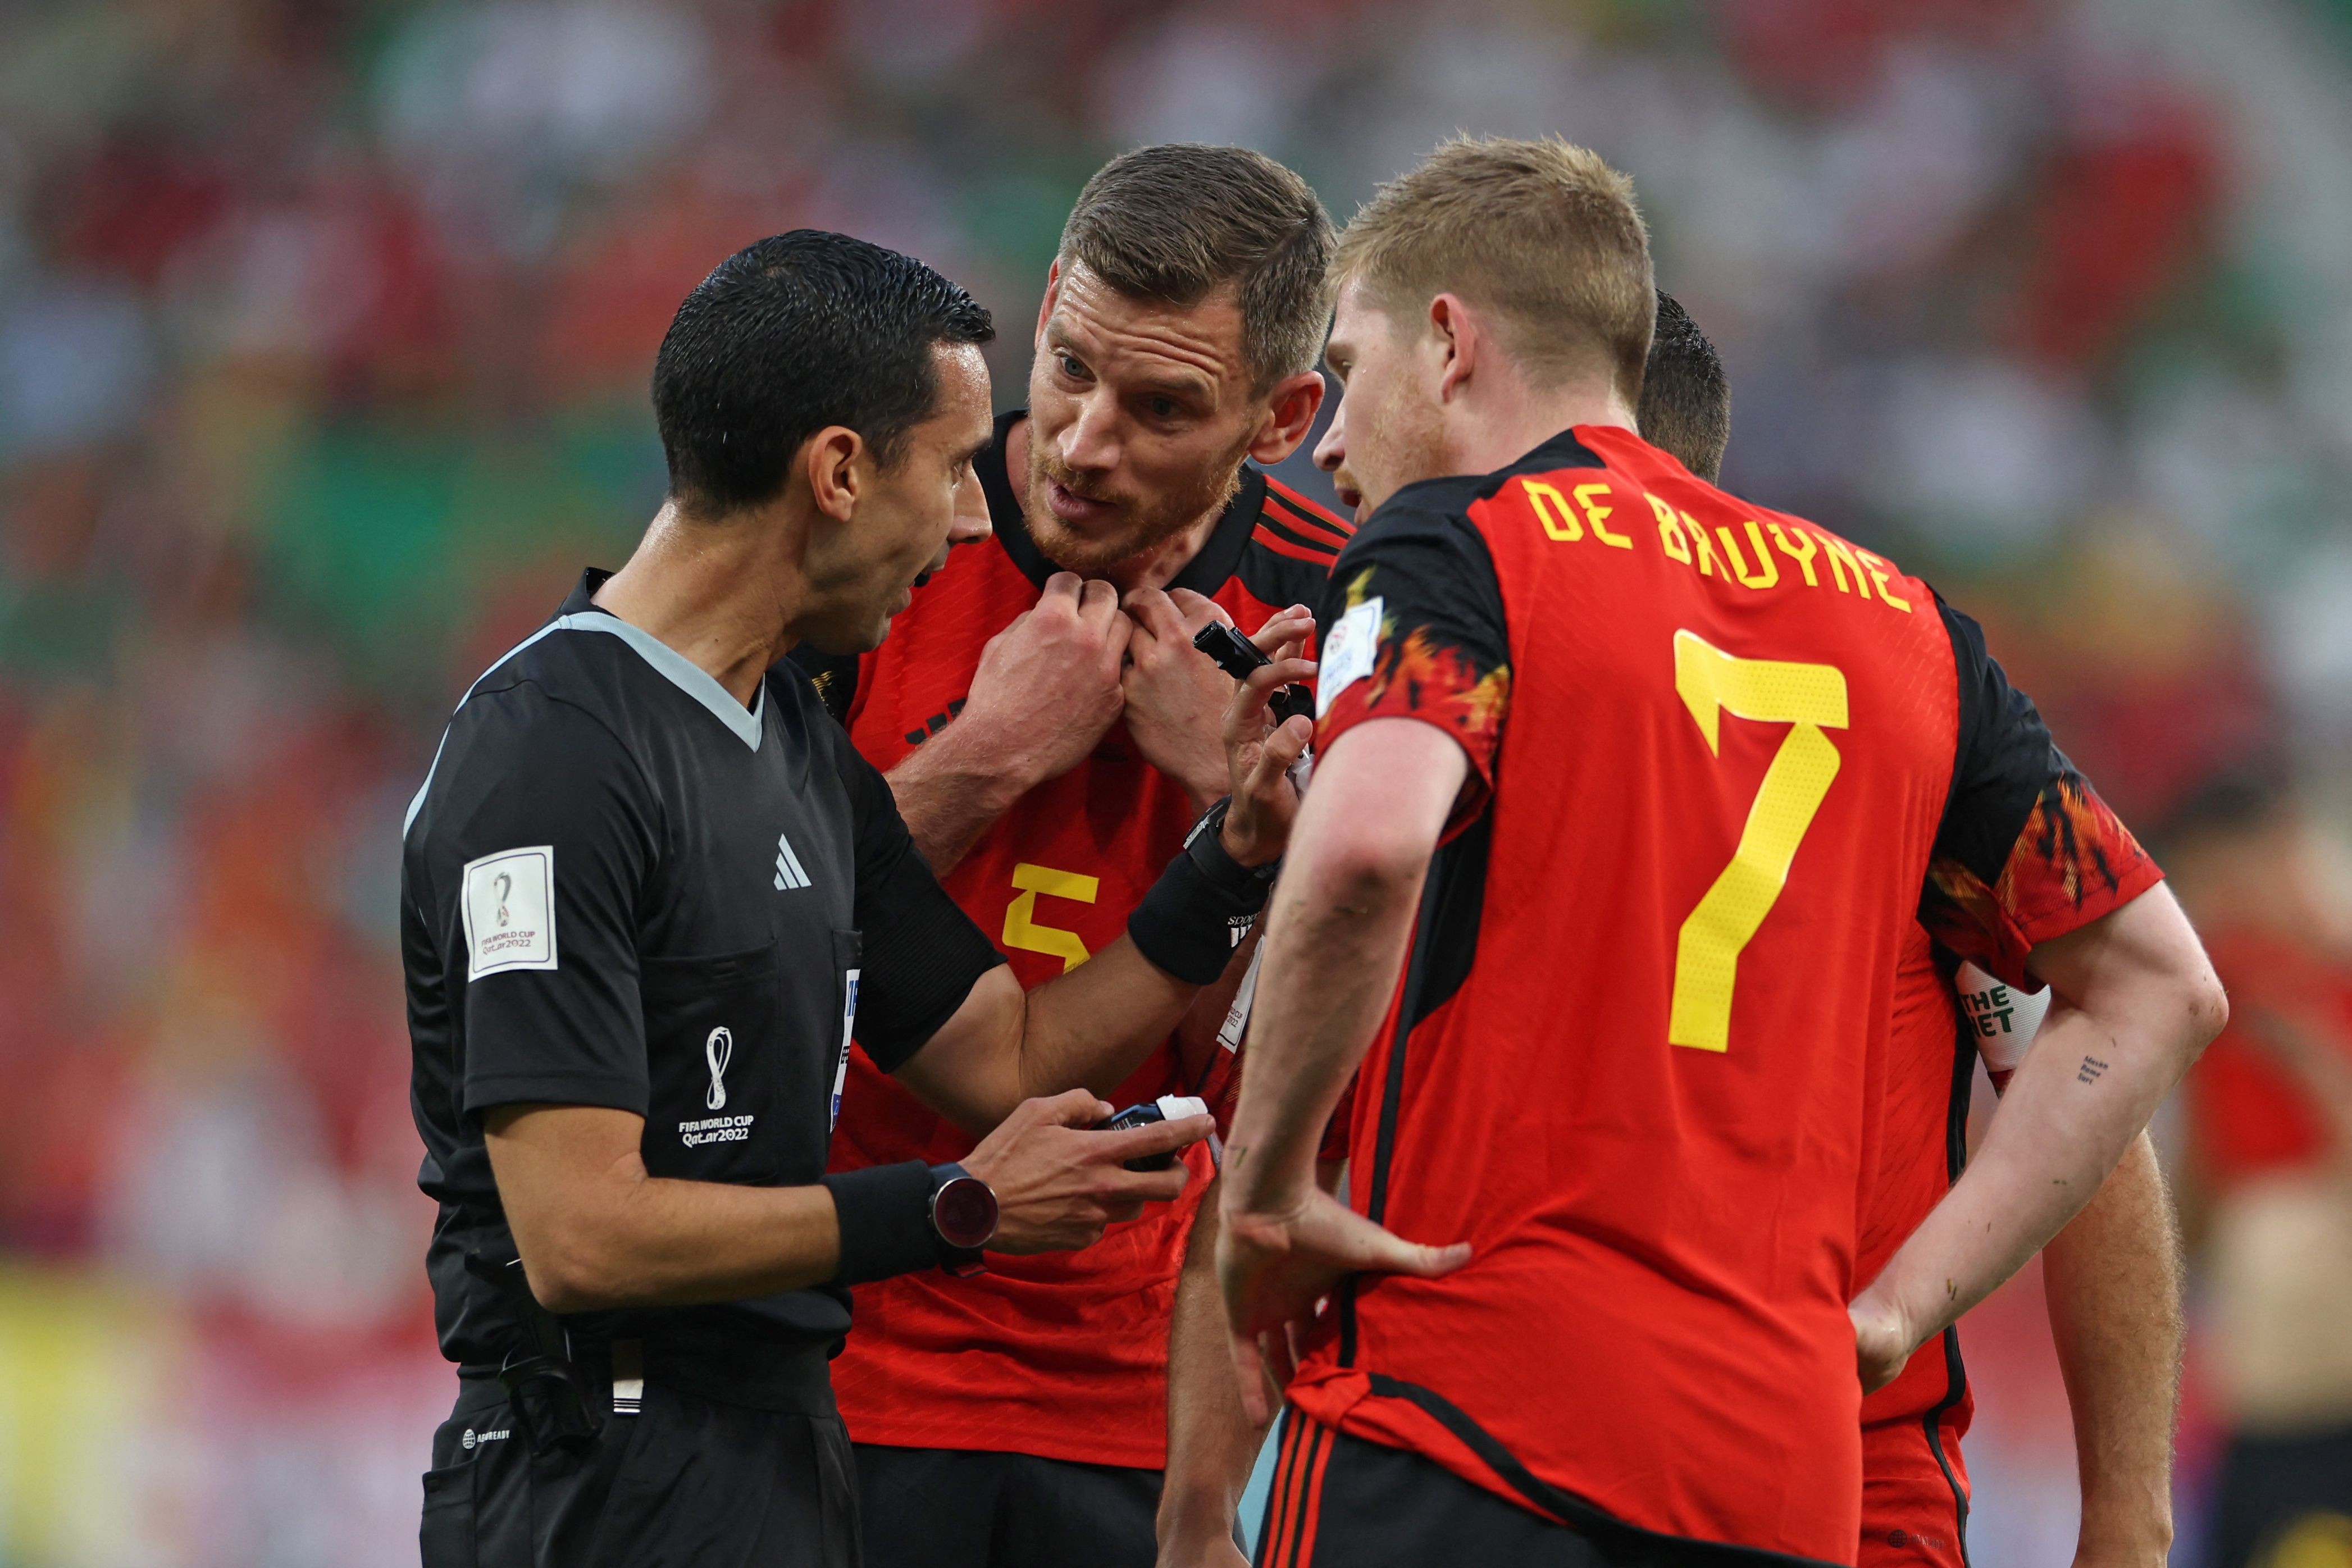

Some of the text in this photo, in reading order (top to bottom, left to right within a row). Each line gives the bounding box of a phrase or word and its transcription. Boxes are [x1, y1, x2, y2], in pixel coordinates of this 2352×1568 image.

[1521, 479, 1911, 612] DE BRUYNE
[1669, 628, 1849, 1053] 7
[1002, 863, 1099, 975] 5
[483, 939, 531, 955] Qatar2022
[493, 932, 517, 942] WORLD
[1960, 984, 2009, 1012] THE
[679, 1115, 754, 1132] FIFA WORLD CUP
[682, 1128, 749, 1148] Qatar2022
